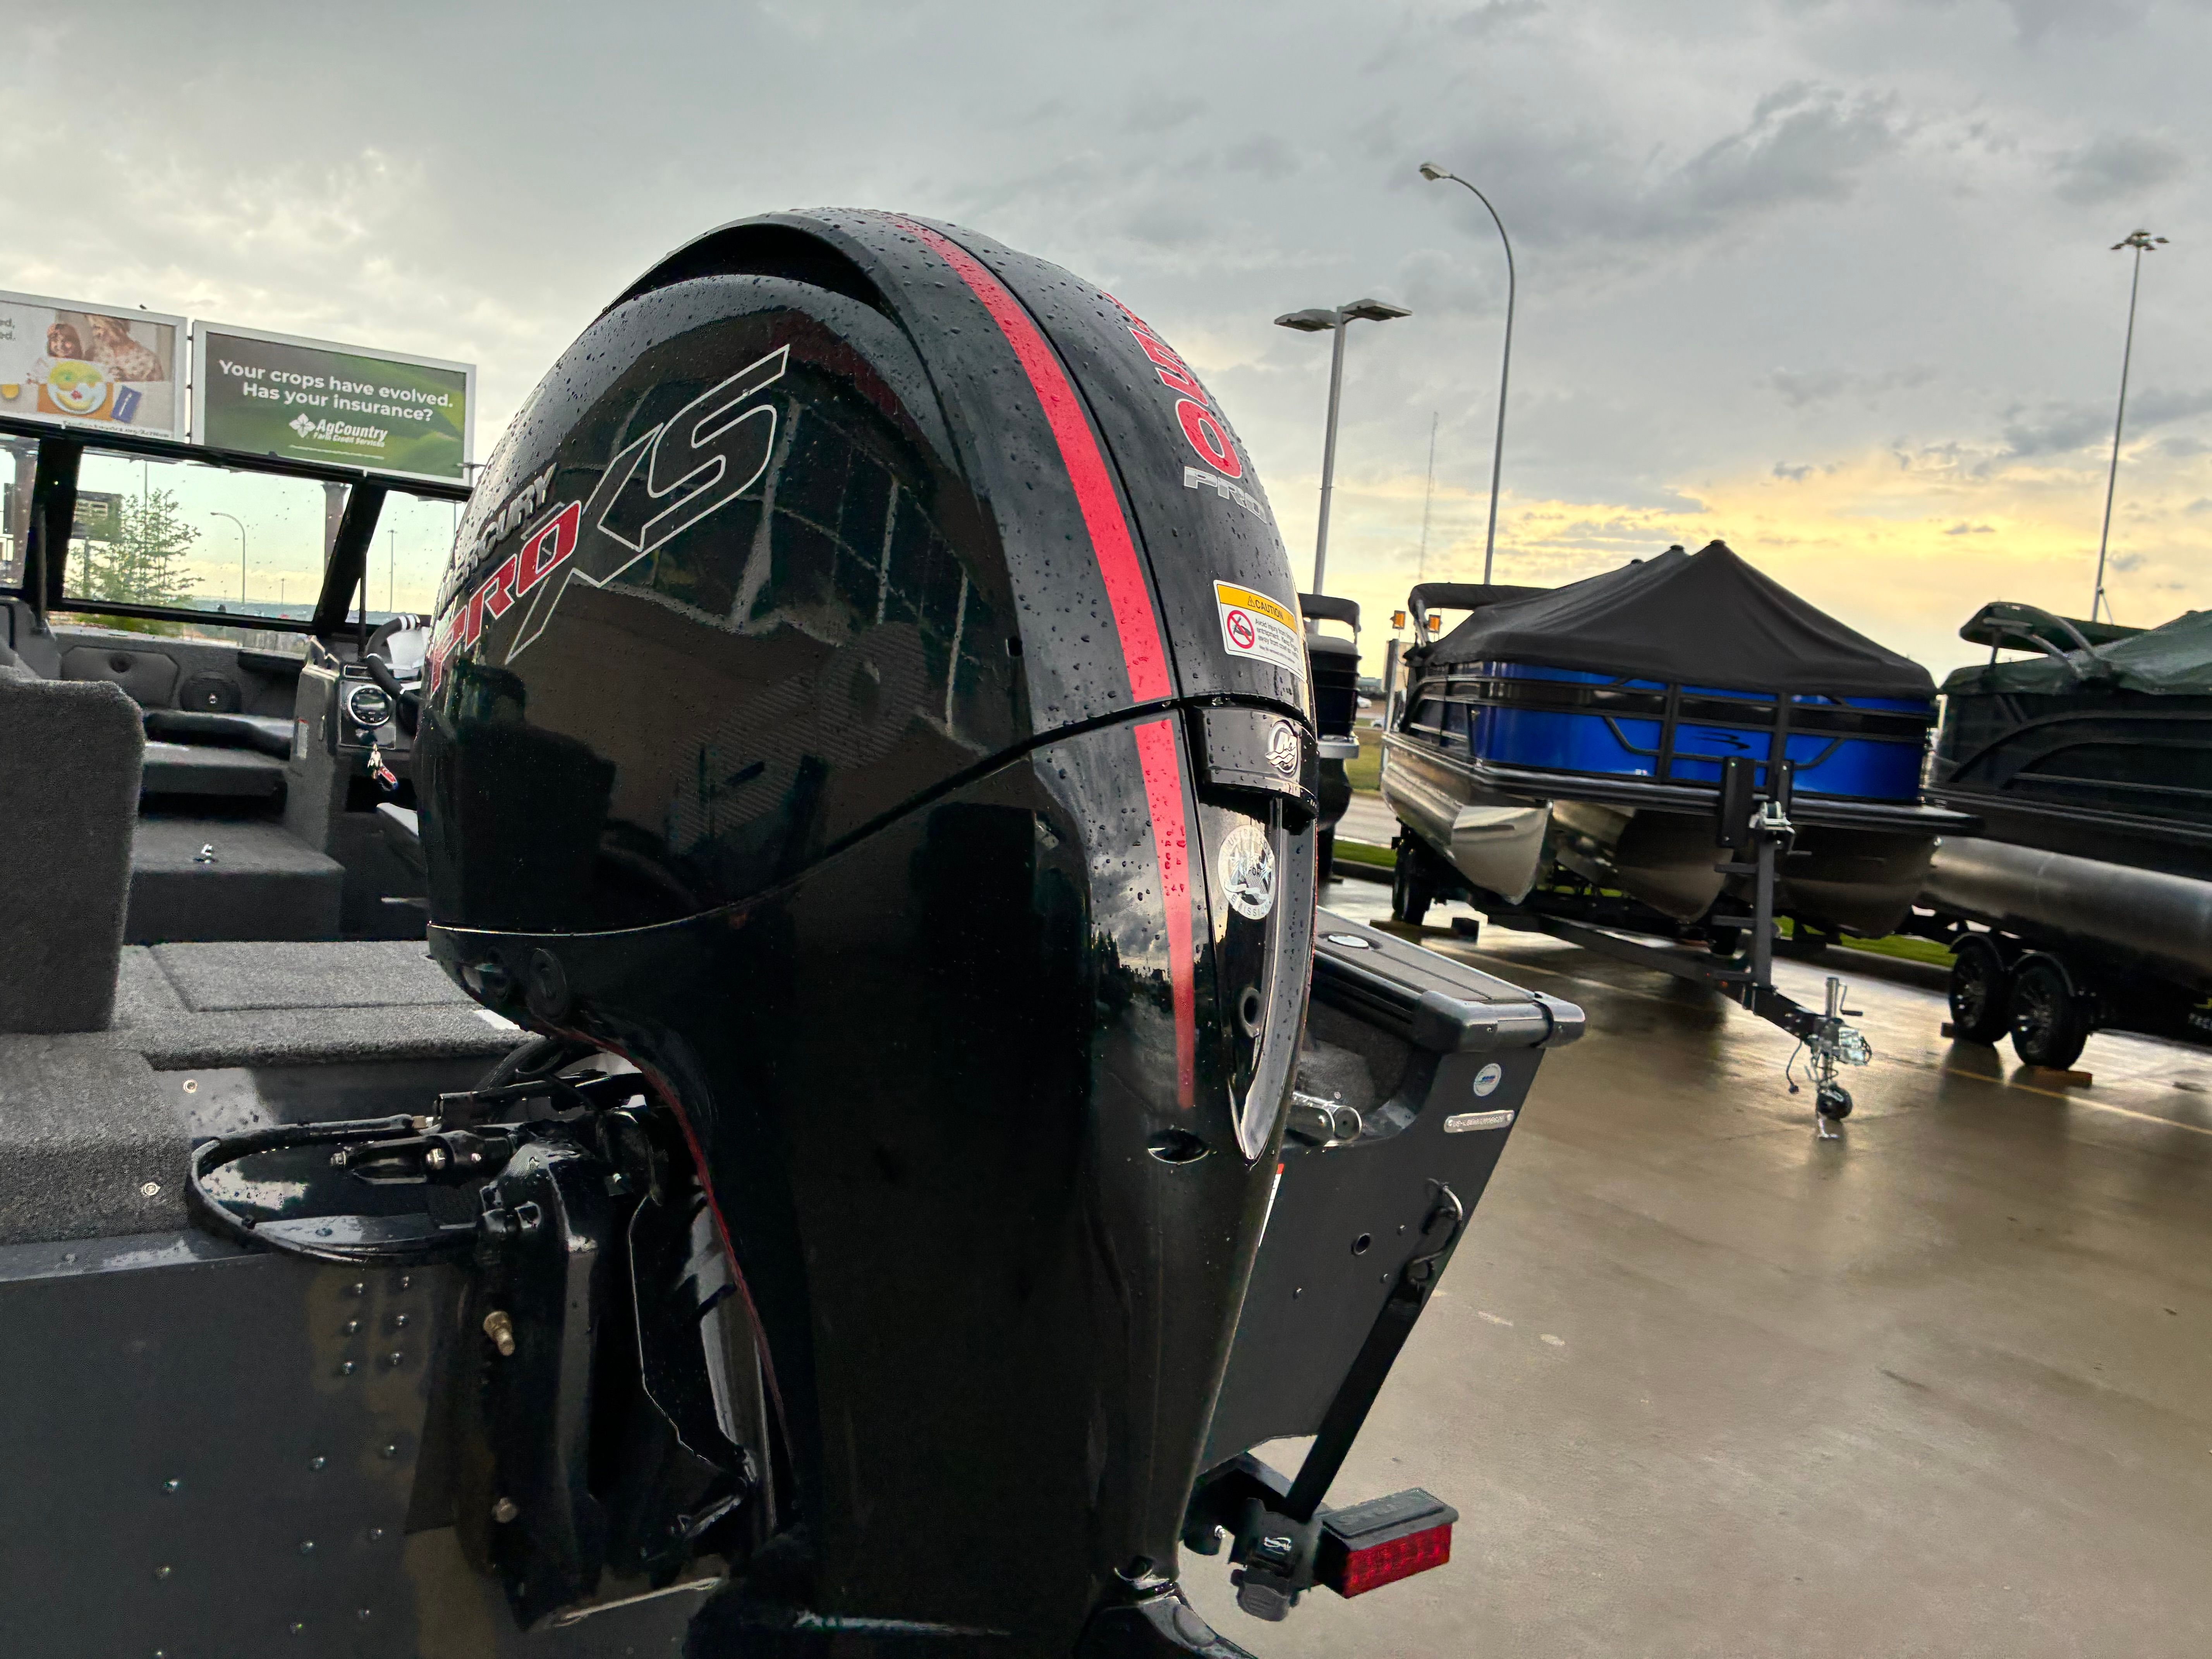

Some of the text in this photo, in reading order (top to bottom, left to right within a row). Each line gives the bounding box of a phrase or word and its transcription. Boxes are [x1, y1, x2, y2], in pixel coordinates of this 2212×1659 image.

[218, 359, 453, 407] Your crops have evolved.
[242, 381, 433, 421] Has your insurance?
[316, 419, 388, 442] AgCountry
[1184, 465, 1267, 524] PRO
[430, 500, 582, 700] PRO
[1255, 599, 1283, 620] CAUTION
[1231, 894, 1271, 917] EISSIO
